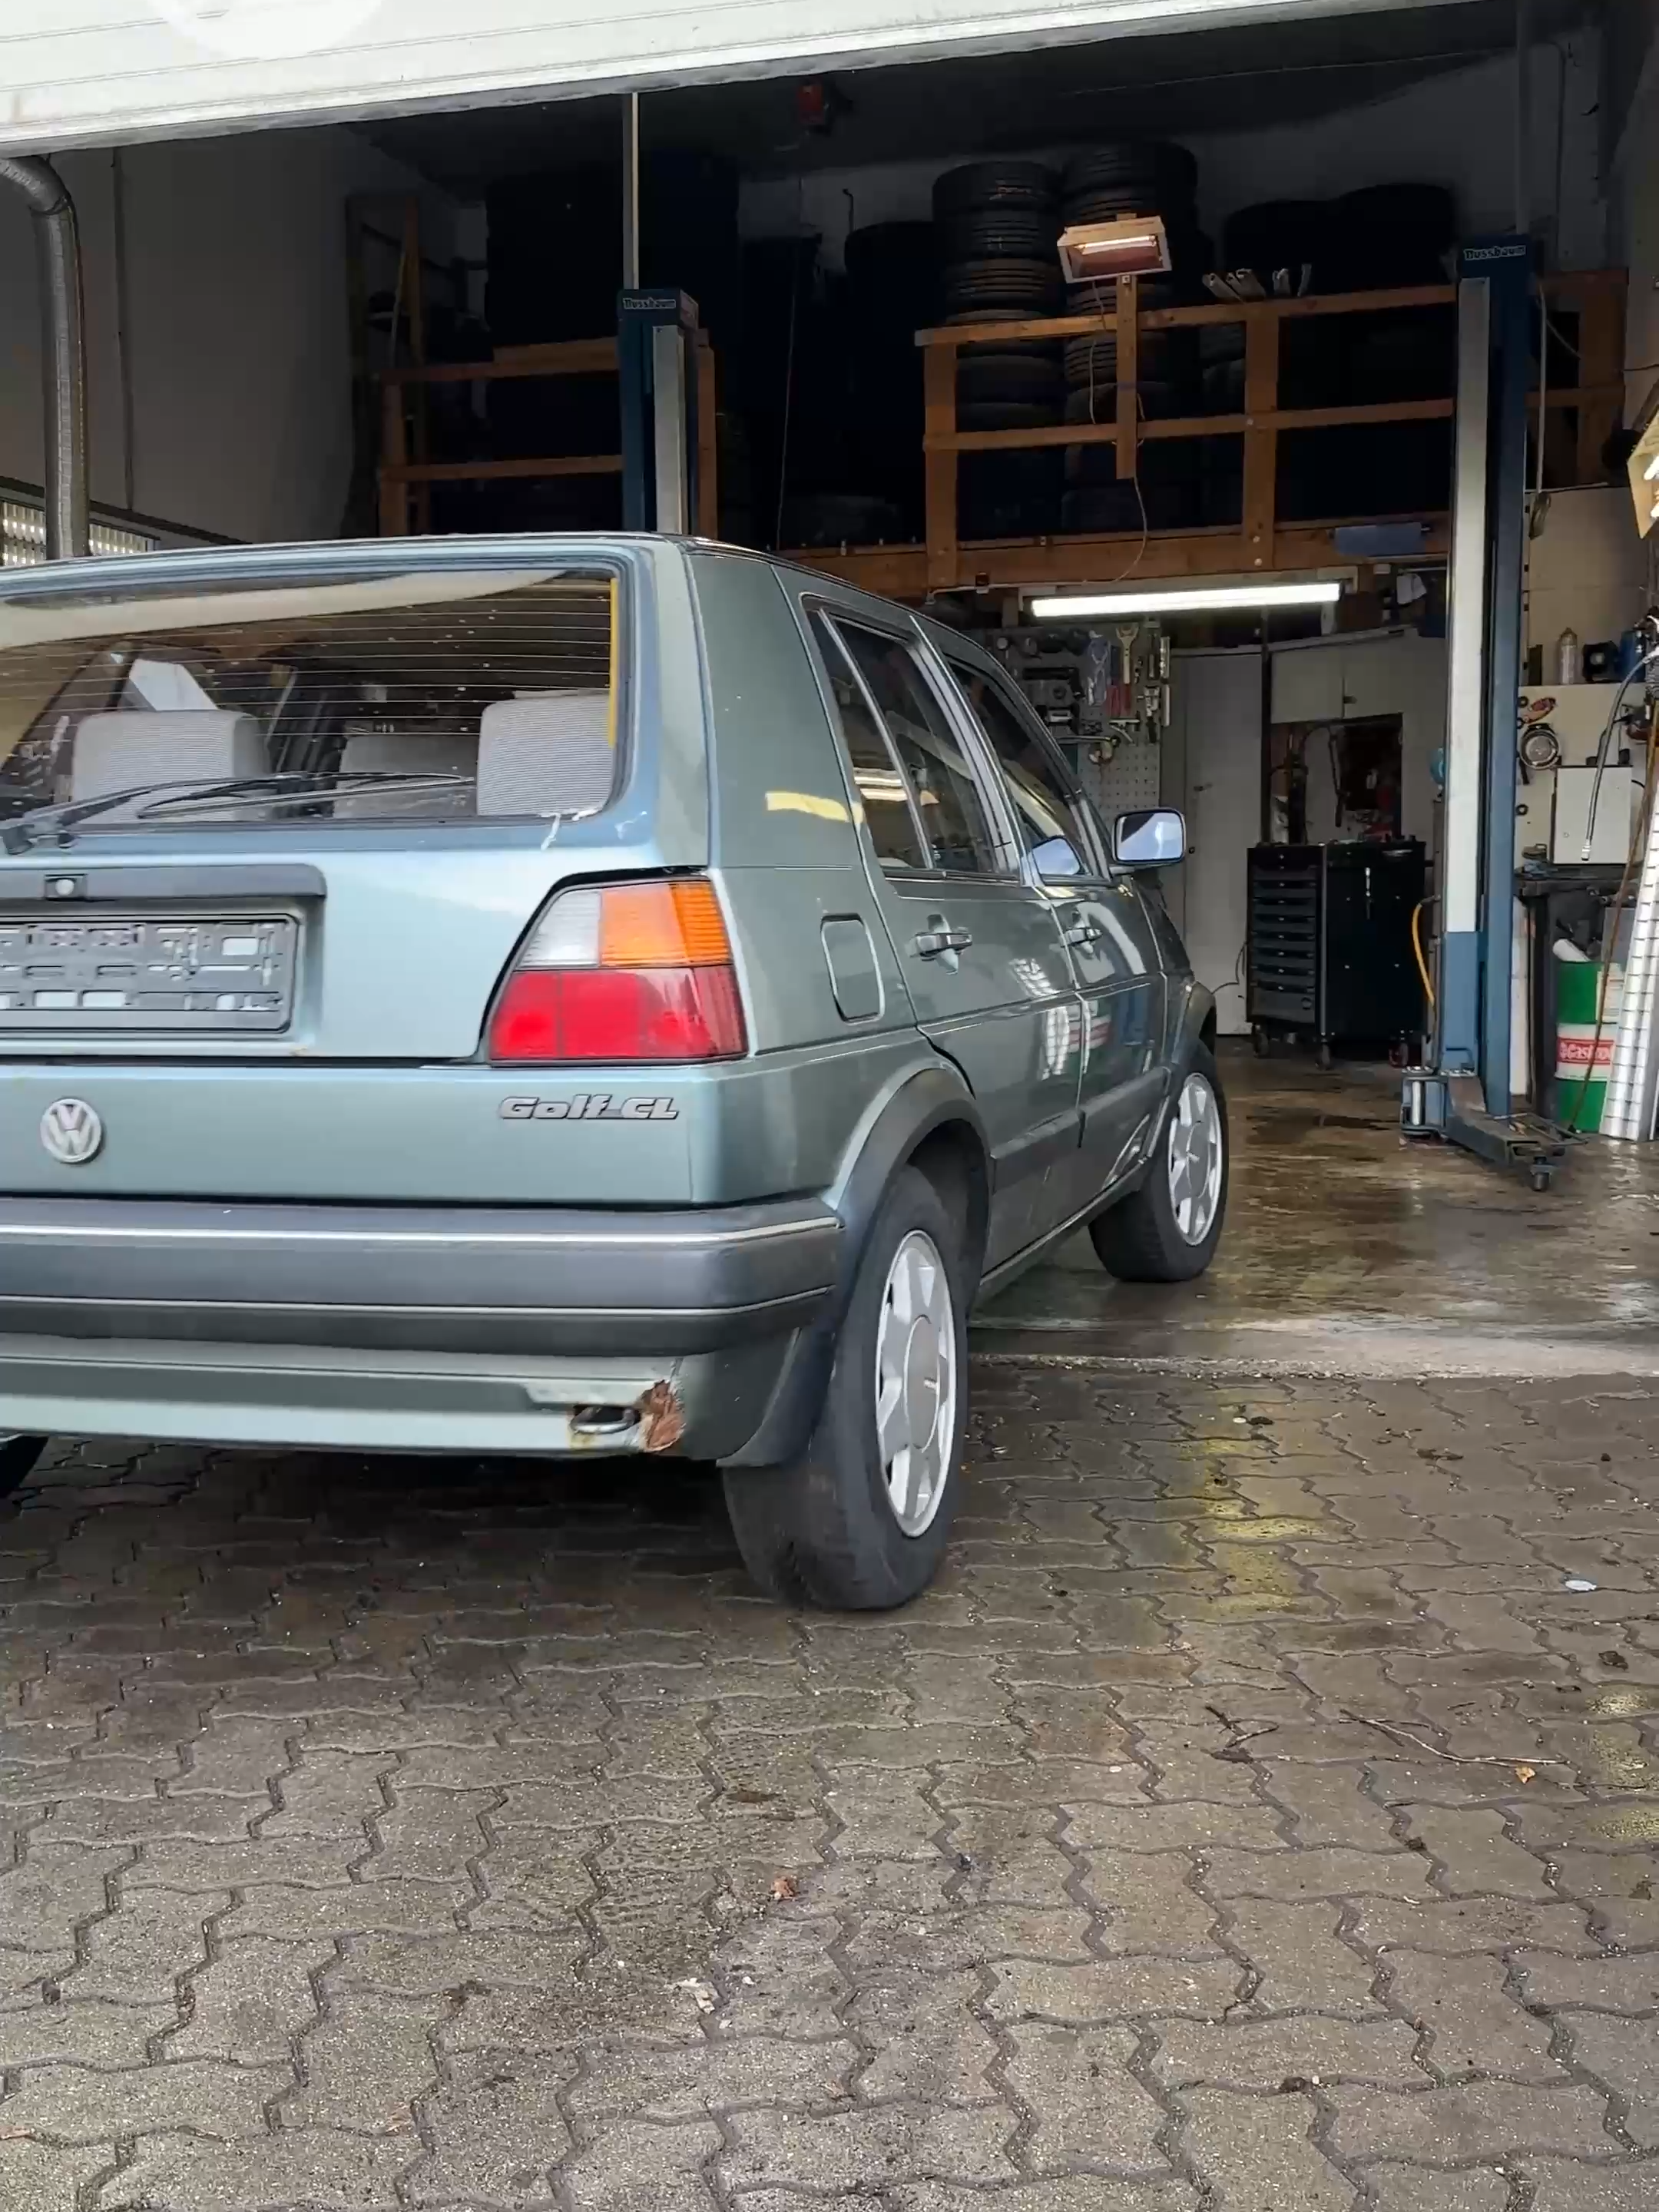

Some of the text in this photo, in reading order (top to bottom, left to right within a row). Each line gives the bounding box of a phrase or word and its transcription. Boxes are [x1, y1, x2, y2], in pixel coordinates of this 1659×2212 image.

[1567, 1042, 1611, 1061] Castro
[499, 1094, 679, 1120] Golf CL
[43, 1100, 99, 1161] VW
